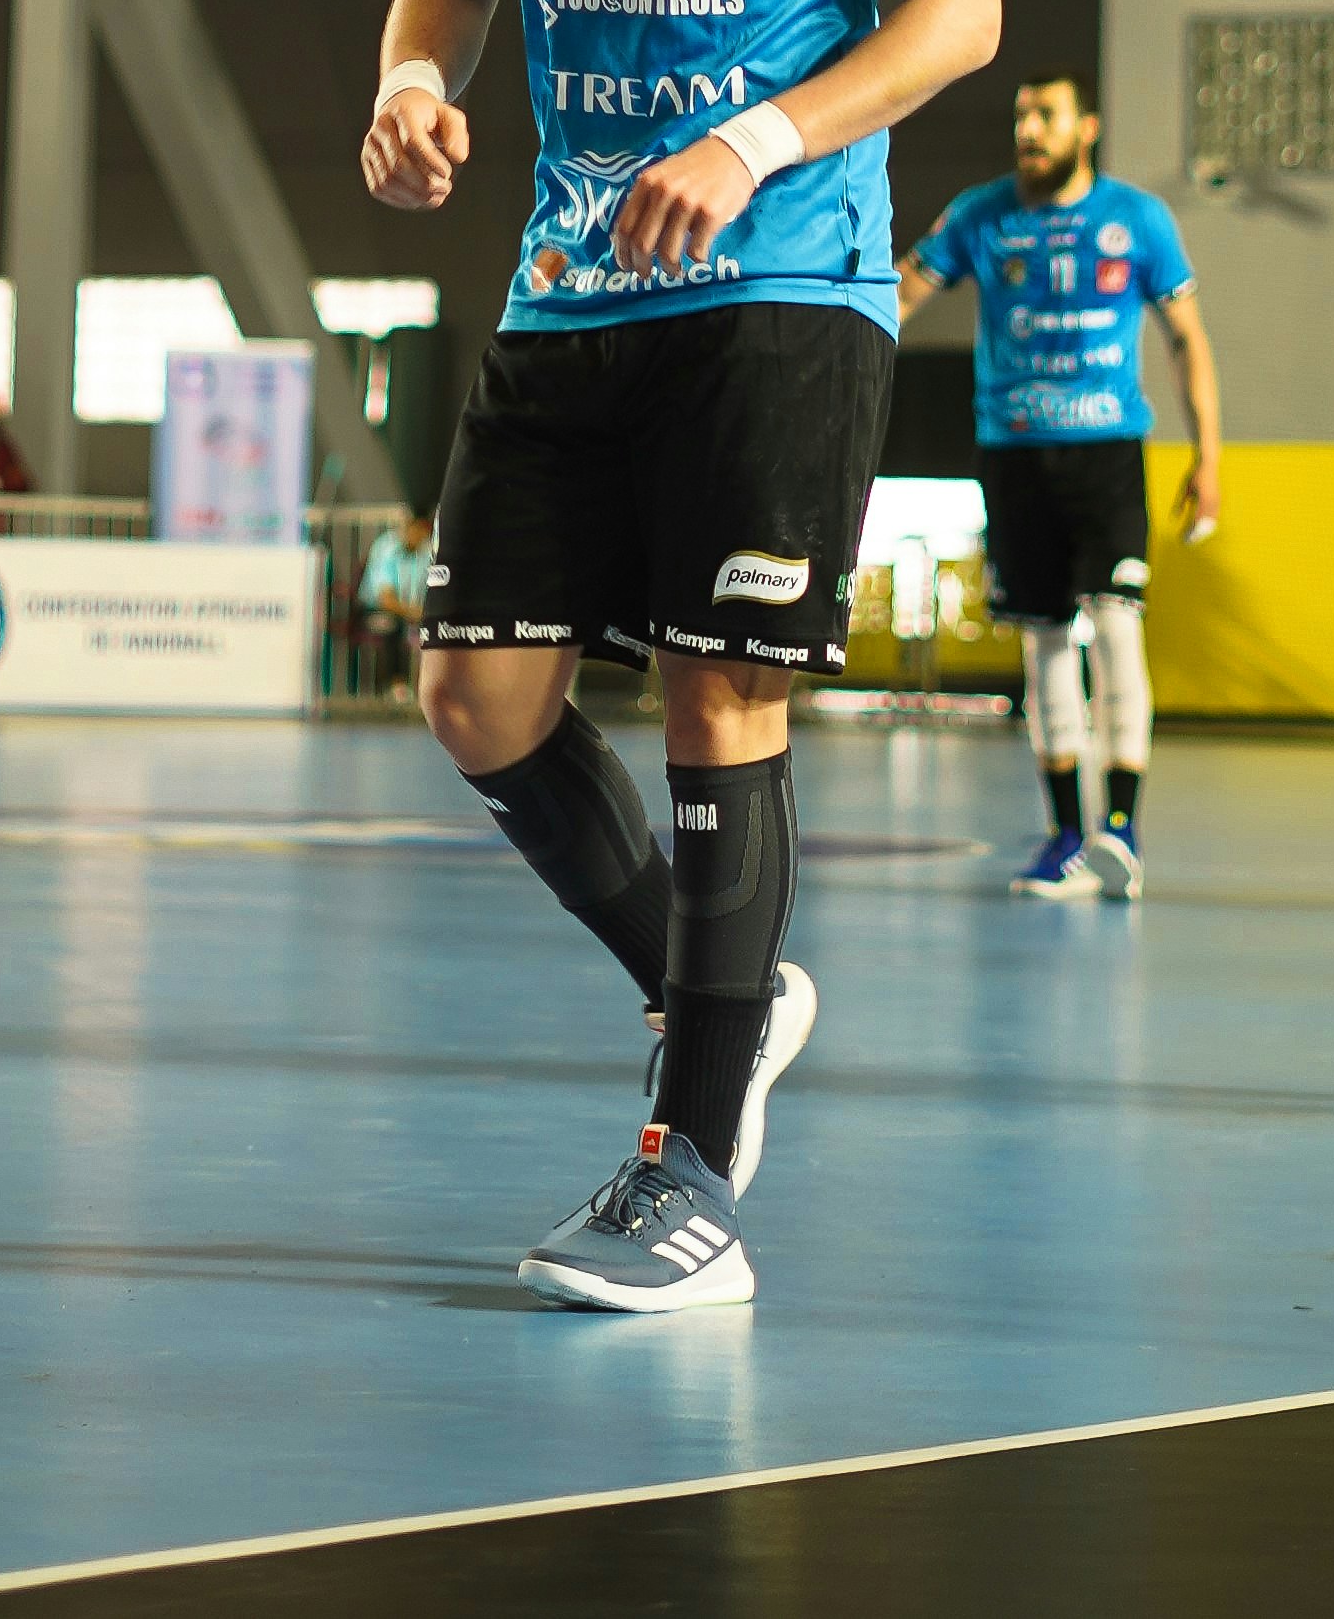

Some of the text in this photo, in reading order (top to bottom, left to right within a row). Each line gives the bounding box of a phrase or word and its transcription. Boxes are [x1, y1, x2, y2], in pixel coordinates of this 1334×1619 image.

[725, 568, 799, 590] palmary
[437, 621, 495, 643] Kempa
[515, 621, 572, 642] Kempa
[665, 625, 726, 653] Kempa
[746, 638, 809, 664] Kempa
[685, 803, 718, 831] NBA
